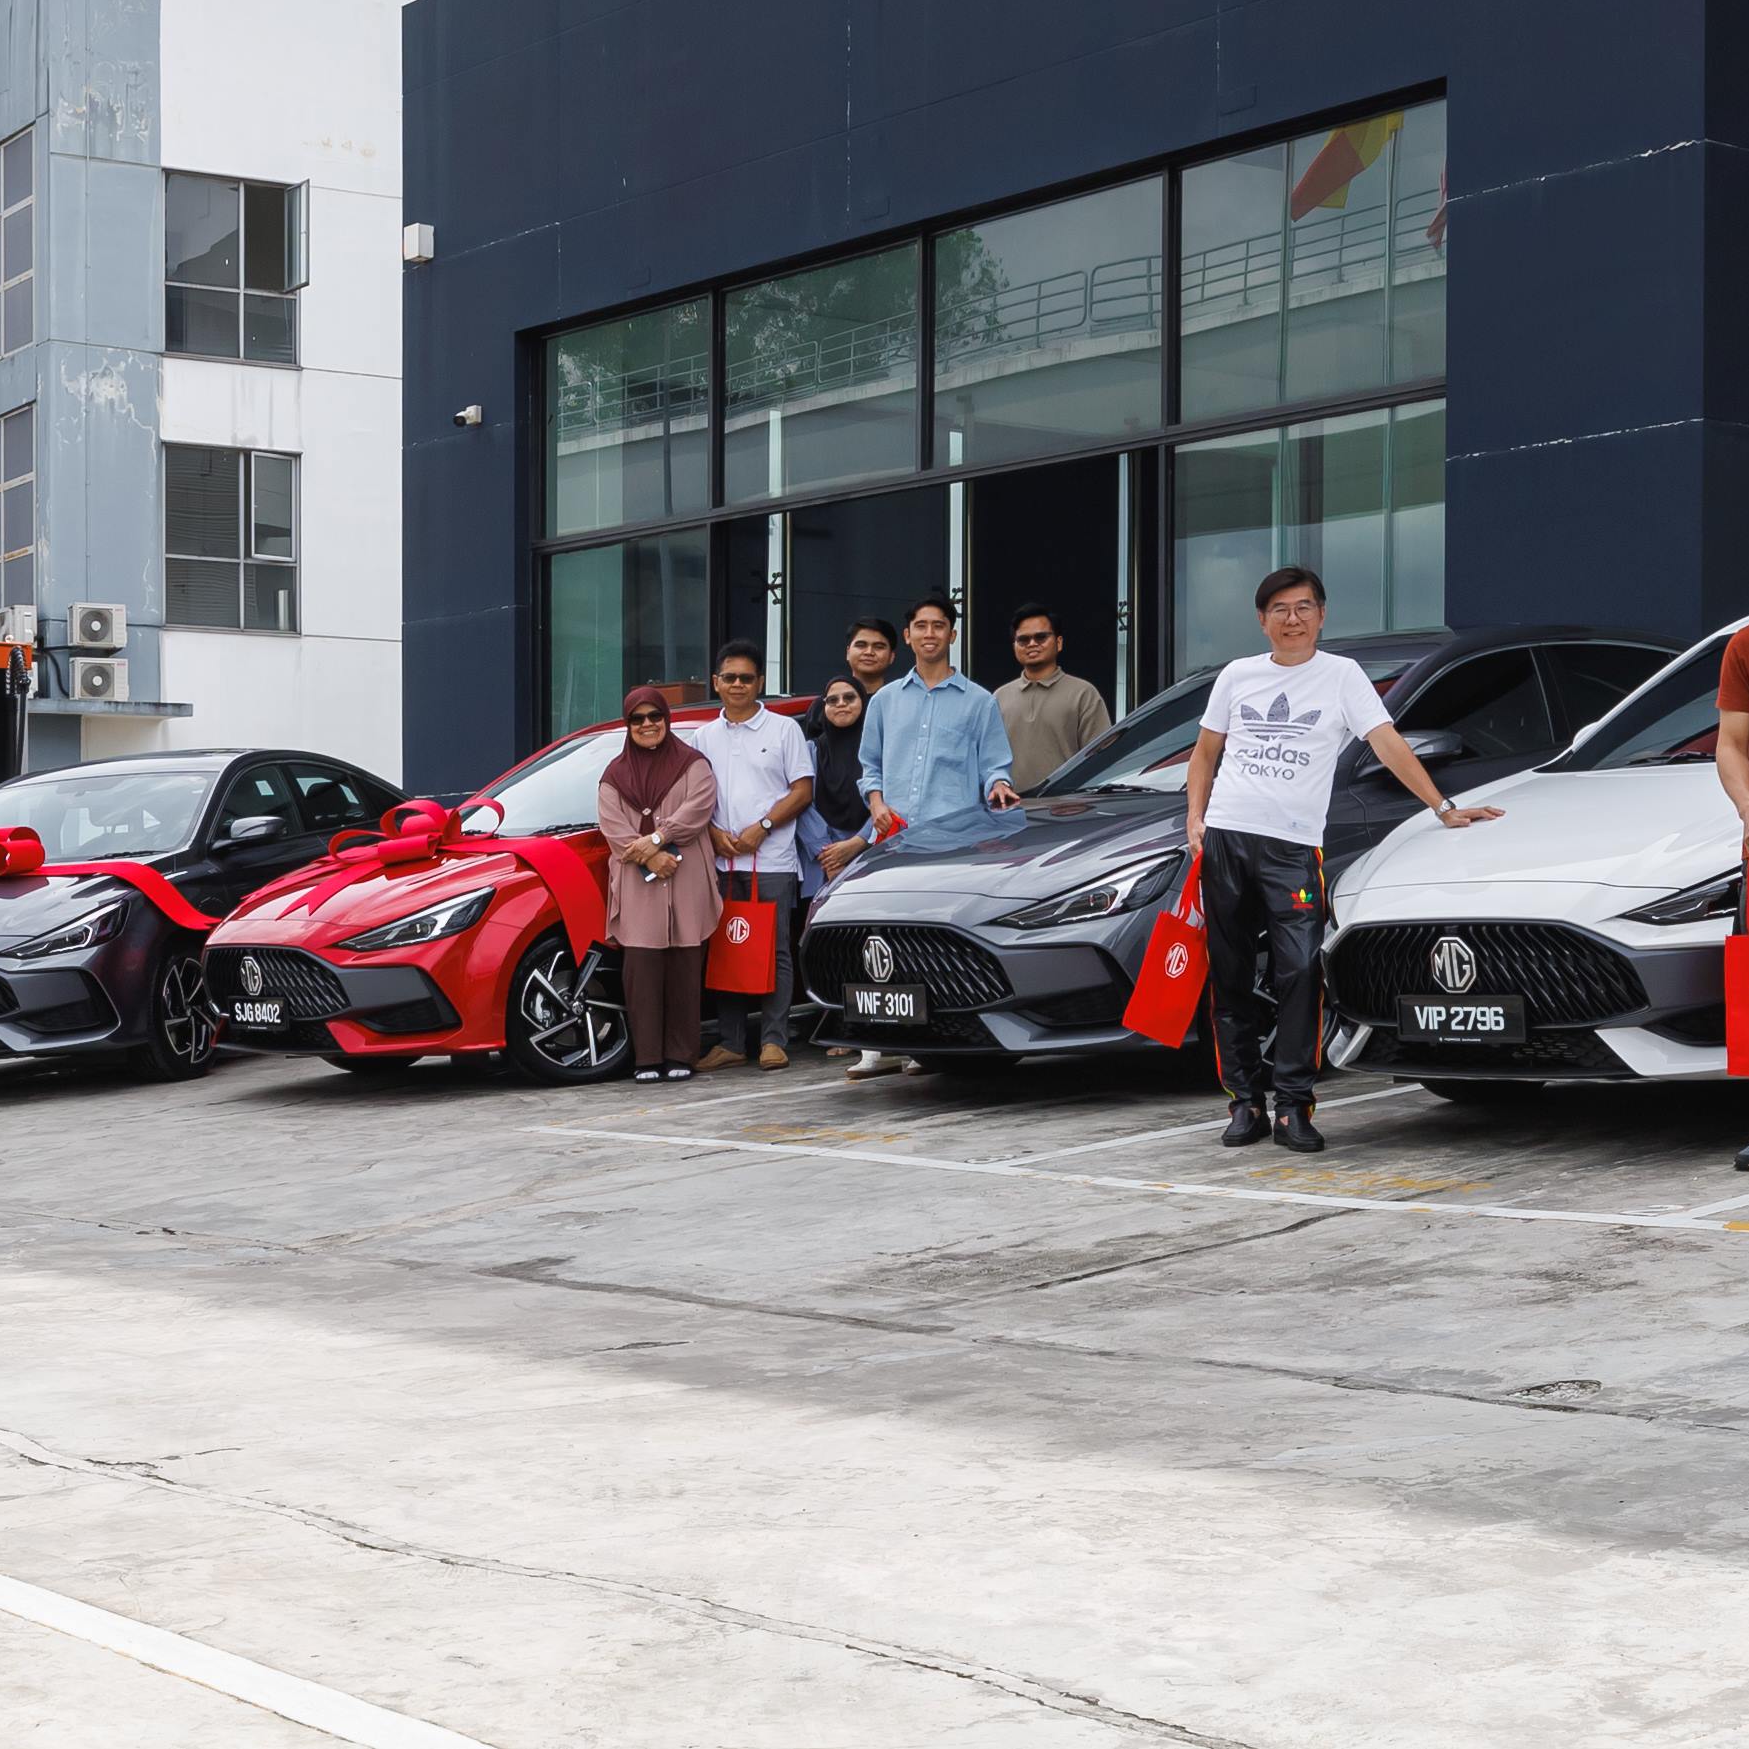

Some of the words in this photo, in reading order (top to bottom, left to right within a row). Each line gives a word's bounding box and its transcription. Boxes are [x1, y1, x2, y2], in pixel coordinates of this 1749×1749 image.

[1240, 763, 1295, 781] TOKYO
[728, 919, 748, 941] MG
[864, 940, 890, 978] MG
[1166, 945, 1186, 975] MG
[1434, 942, 1471, 988] MG
[234, 1002, 254, 1022] SJG
[254, 1003, 281, 1023] 8402
[855, 990, 881, 1014] VNF
[884, 992, 914, 1017] 3101
[1414, 1005, 1447, 1030] VIP
[1450, 1006, 1505, 1031] 2796
